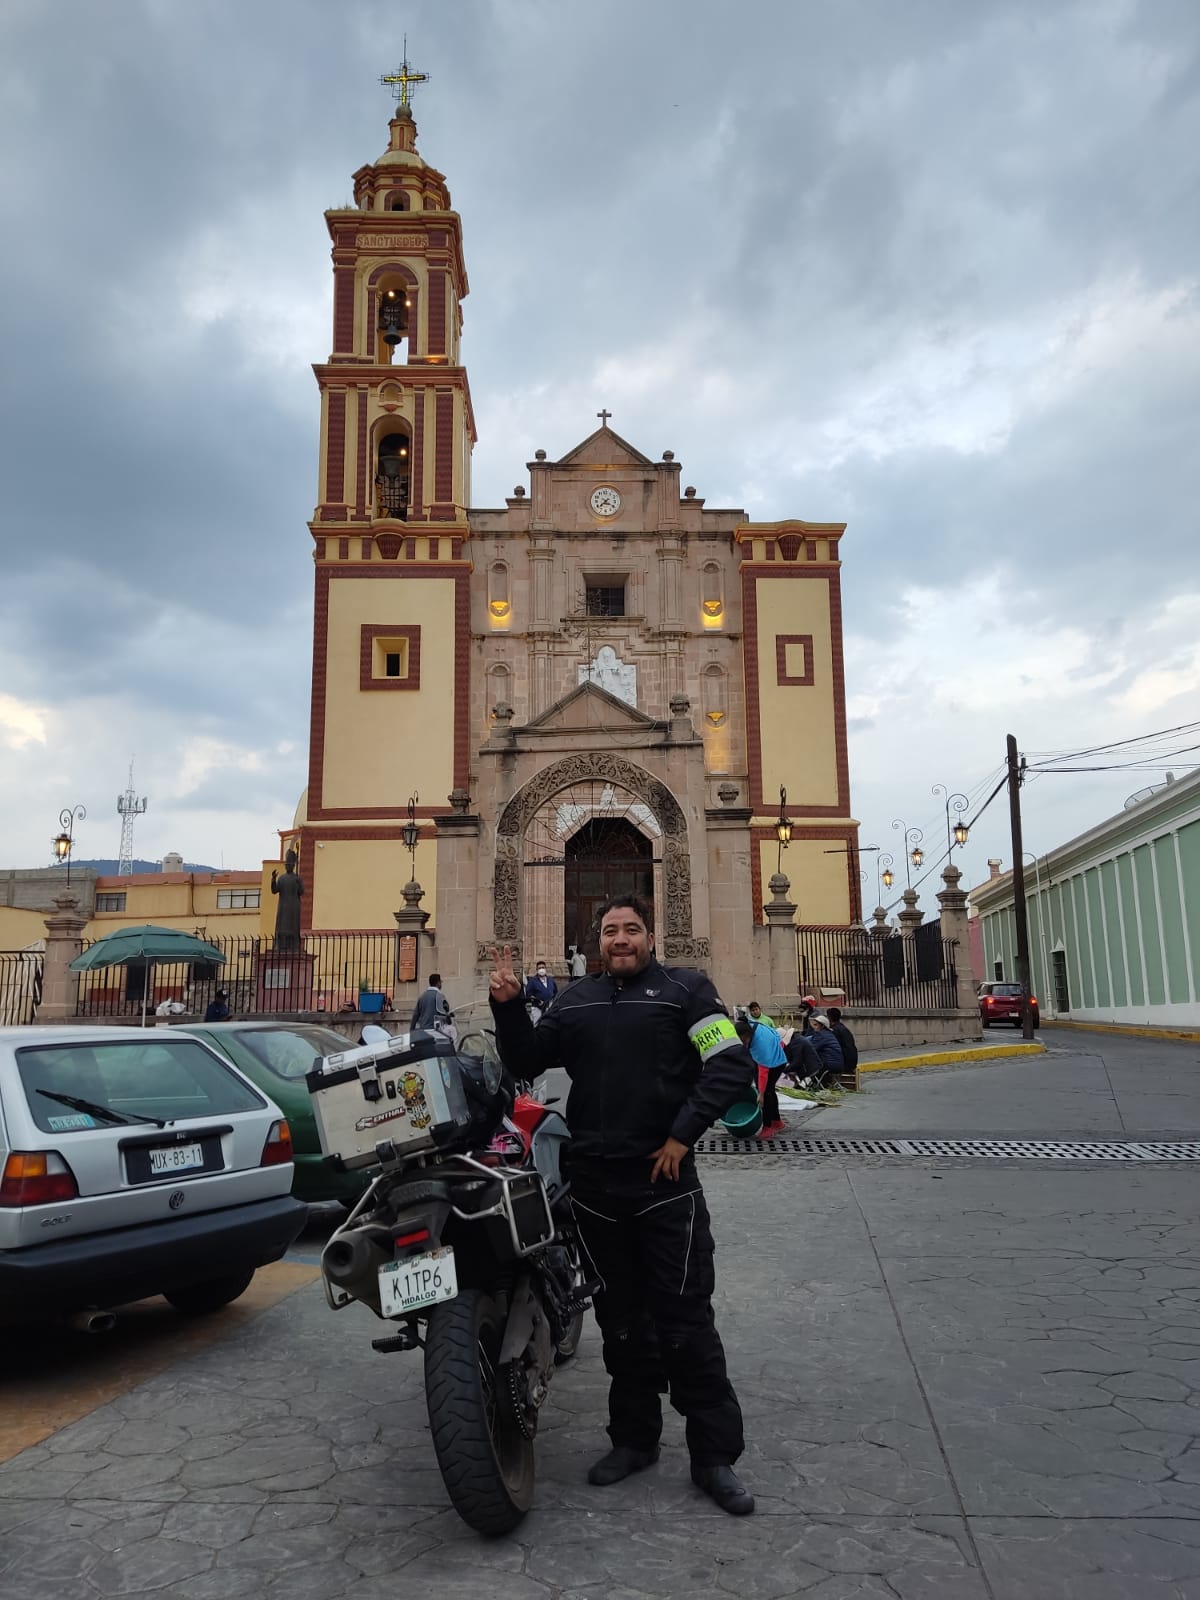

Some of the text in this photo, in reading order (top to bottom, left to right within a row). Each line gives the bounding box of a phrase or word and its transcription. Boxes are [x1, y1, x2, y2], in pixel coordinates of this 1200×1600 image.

[697, 1026, 722, 1047] RRM
[151, 1148, 203, 1169] MUX-83-11
[393, 1266, 442, 1300] K1TP6
[401, 1290, 437, 1307] HIDALGO
